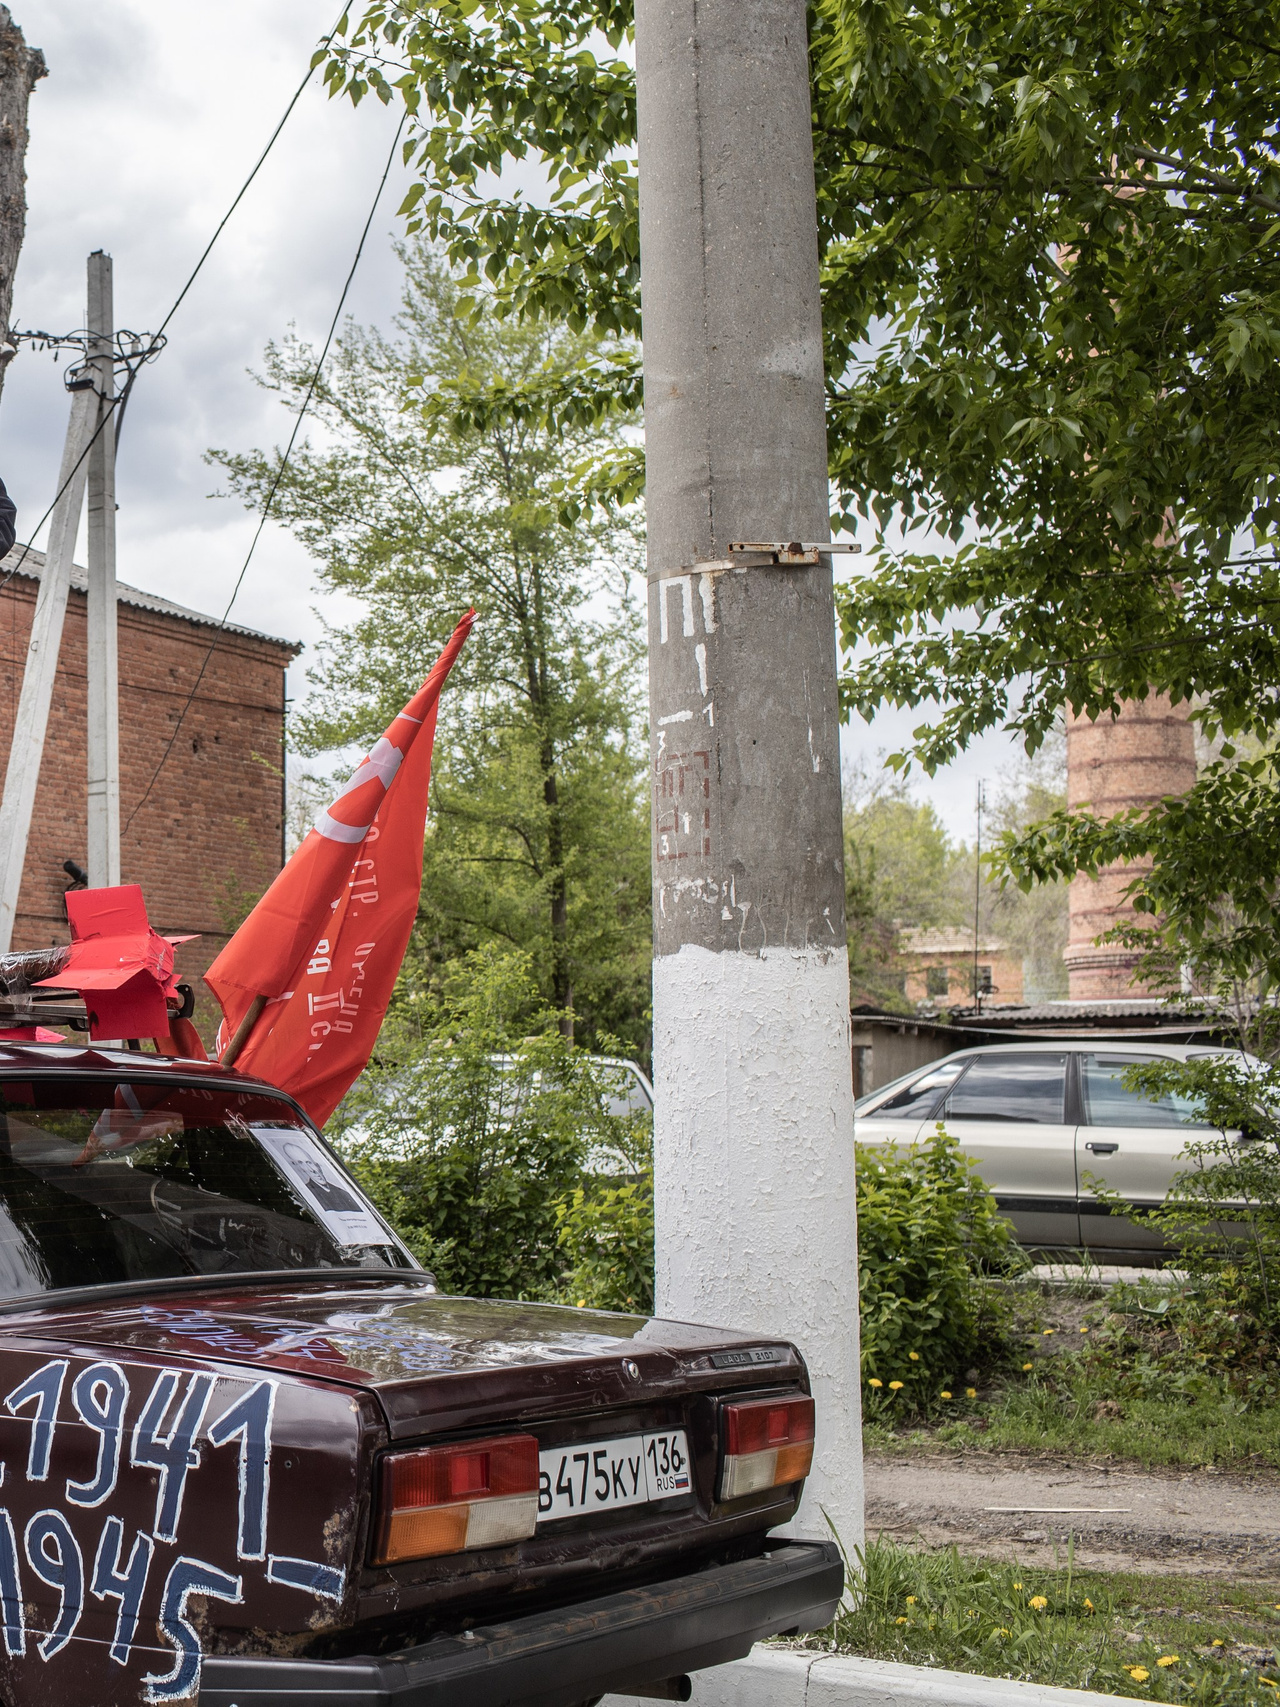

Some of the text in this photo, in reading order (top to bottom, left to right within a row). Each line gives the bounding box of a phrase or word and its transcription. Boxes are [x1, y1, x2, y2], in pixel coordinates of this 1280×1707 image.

[721, 1350, 774, 1365] LADA 2107
[647, 1435, 682, 1477] 136
[656, 1475, 675, 1493] RUS
